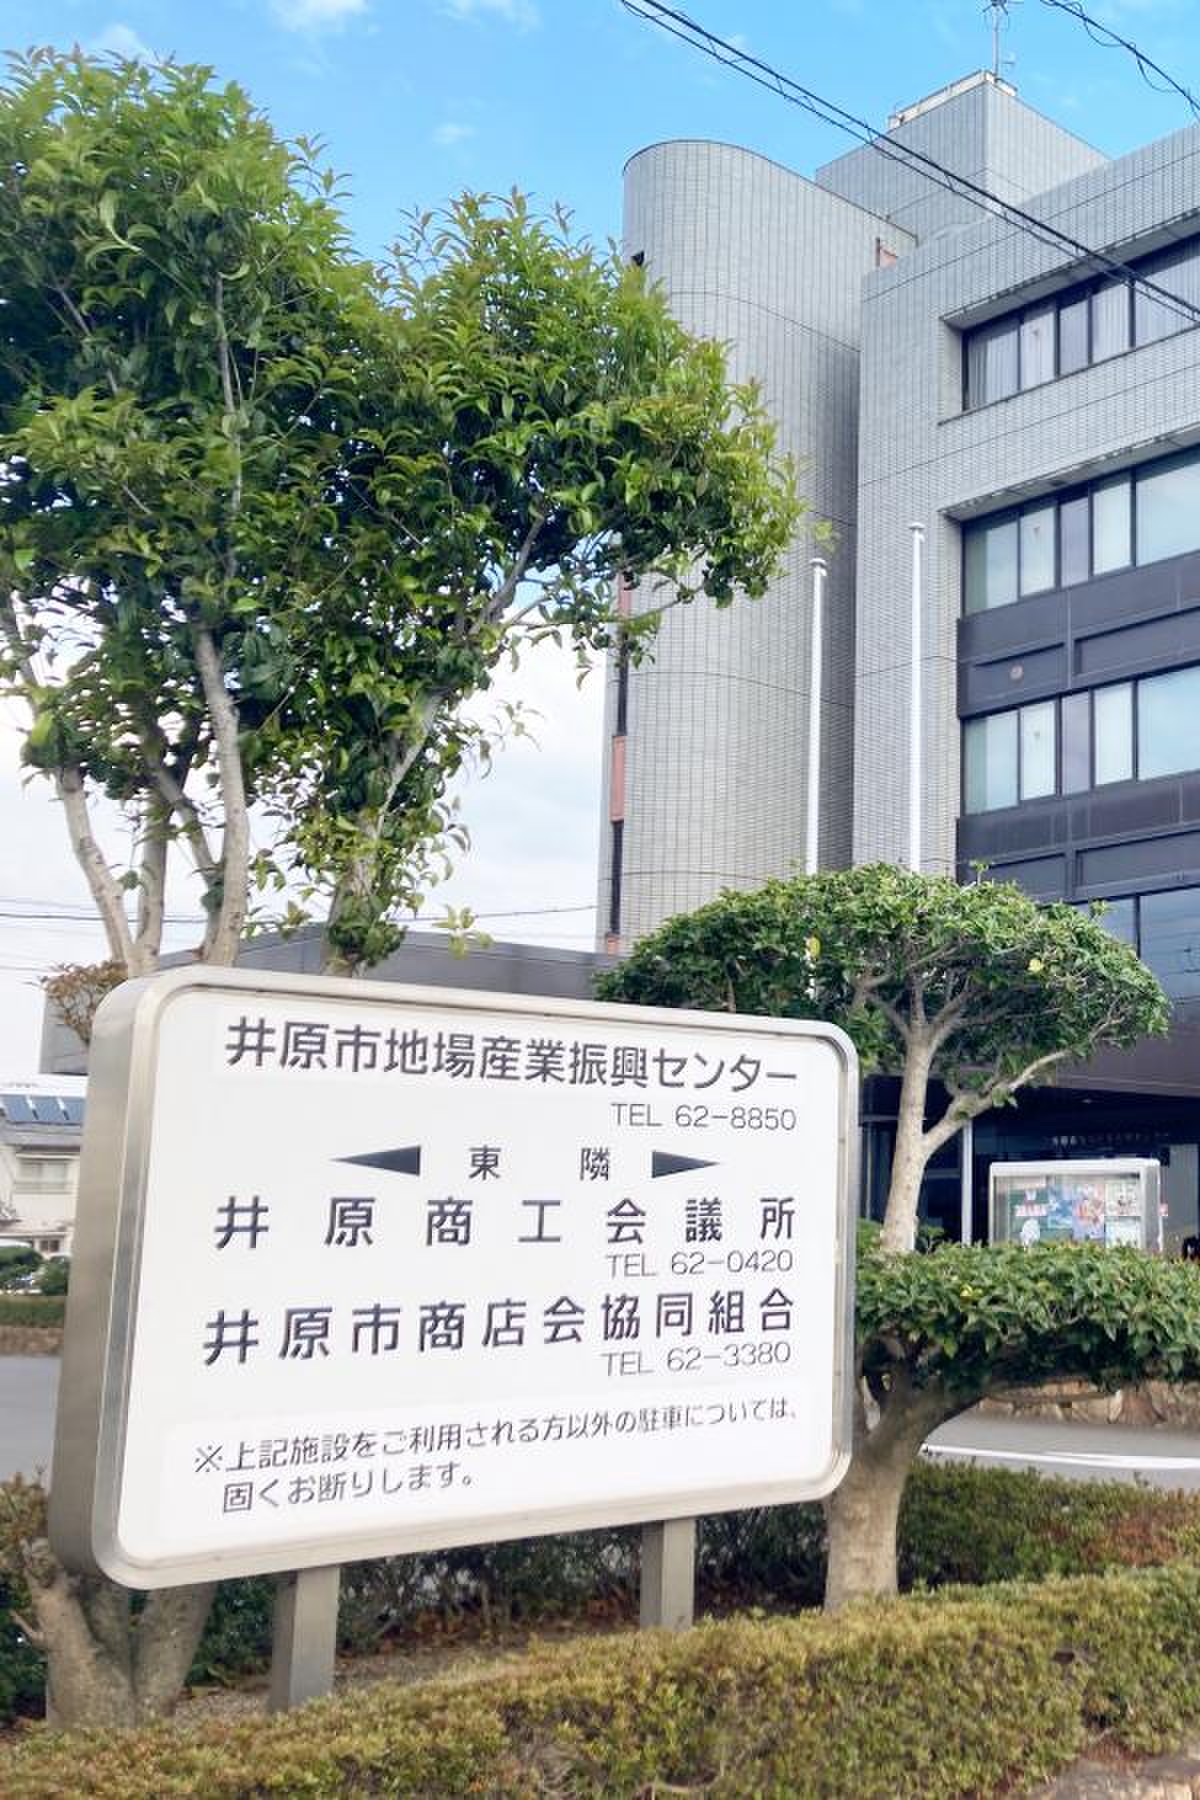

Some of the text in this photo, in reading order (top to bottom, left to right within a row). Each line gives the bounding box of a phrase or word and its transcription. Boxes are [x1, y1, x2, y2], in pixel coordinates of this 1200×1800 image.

[225, 1015, 798, 1093] 井原市地場産業振興センター
[611, 1102, 797, 1131] TEL 62-8850
[215, 1196, 796, 1249] 井原商工会議所
[606, 1249, 793, 1279] TEL 62-0420
[203, 1287, 794, 1367] 井原市商店会協同組合
[601, 1341, 791, 1376] TEL 62-3380
[223, 1461, 473, 1514] 固くお断りします。
